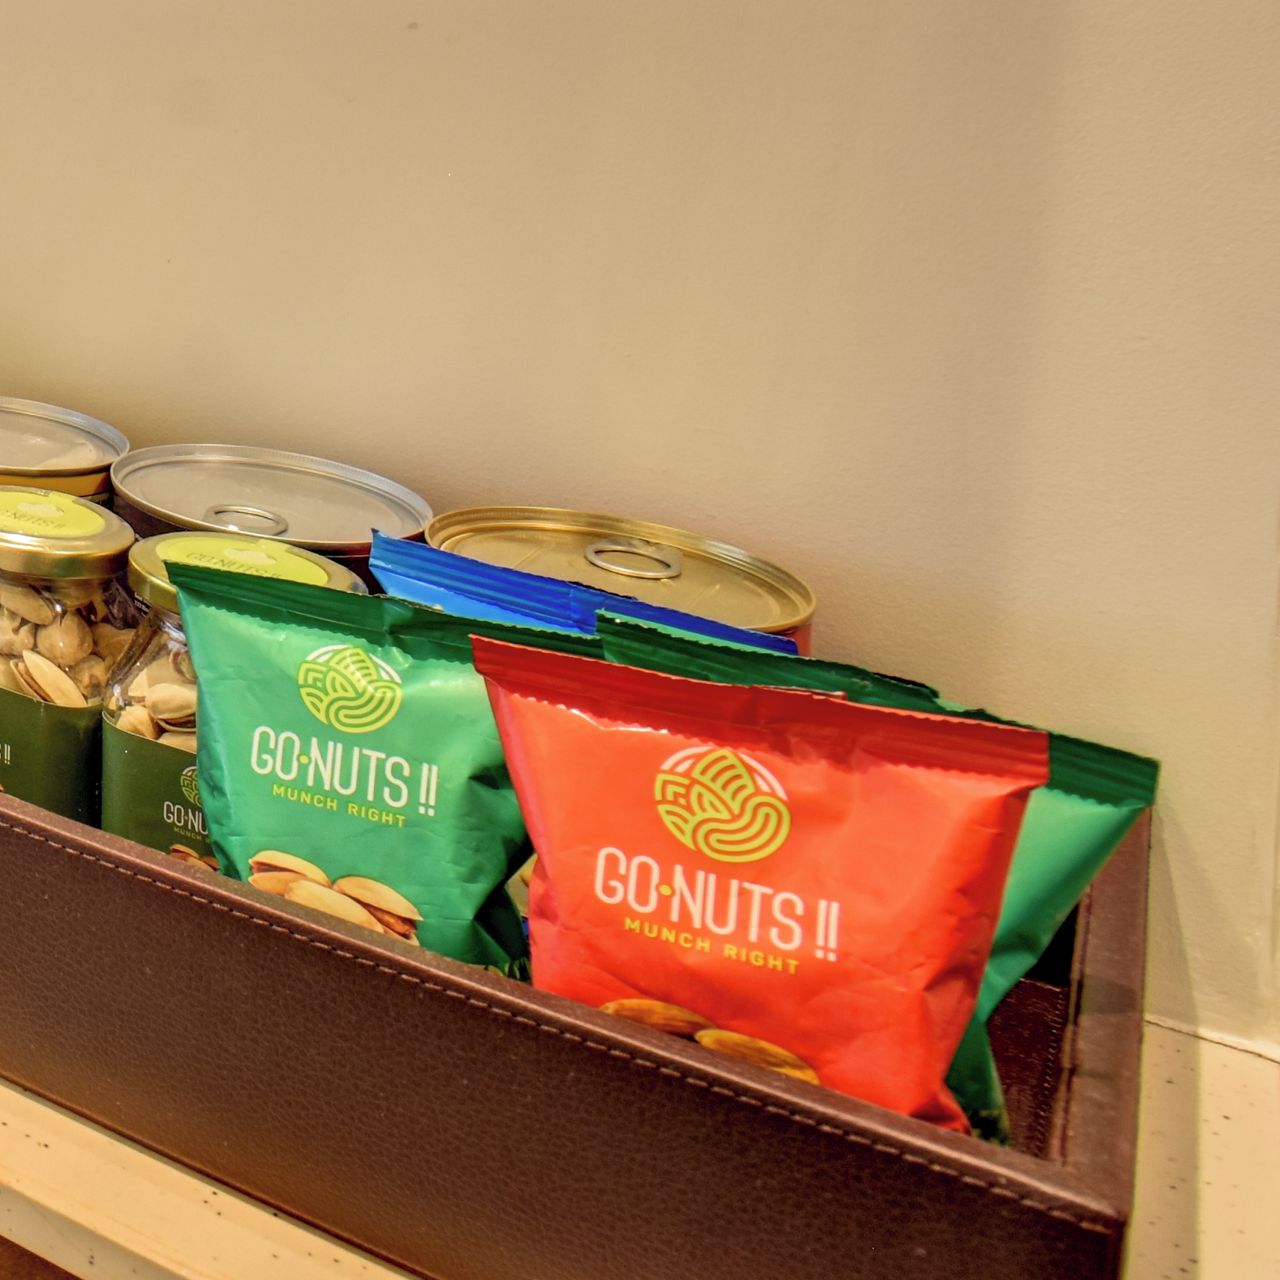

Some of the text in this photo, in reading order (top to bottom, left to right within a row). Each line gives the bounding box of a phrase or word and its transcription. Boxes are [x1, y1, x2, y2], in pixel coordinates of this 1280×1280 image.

[272, 783, 407, 828] MUNCH RIGHT
[174, 827, 202, 840] MUNCH
[624, 916, 799, 975] MUNCH RIGHT
